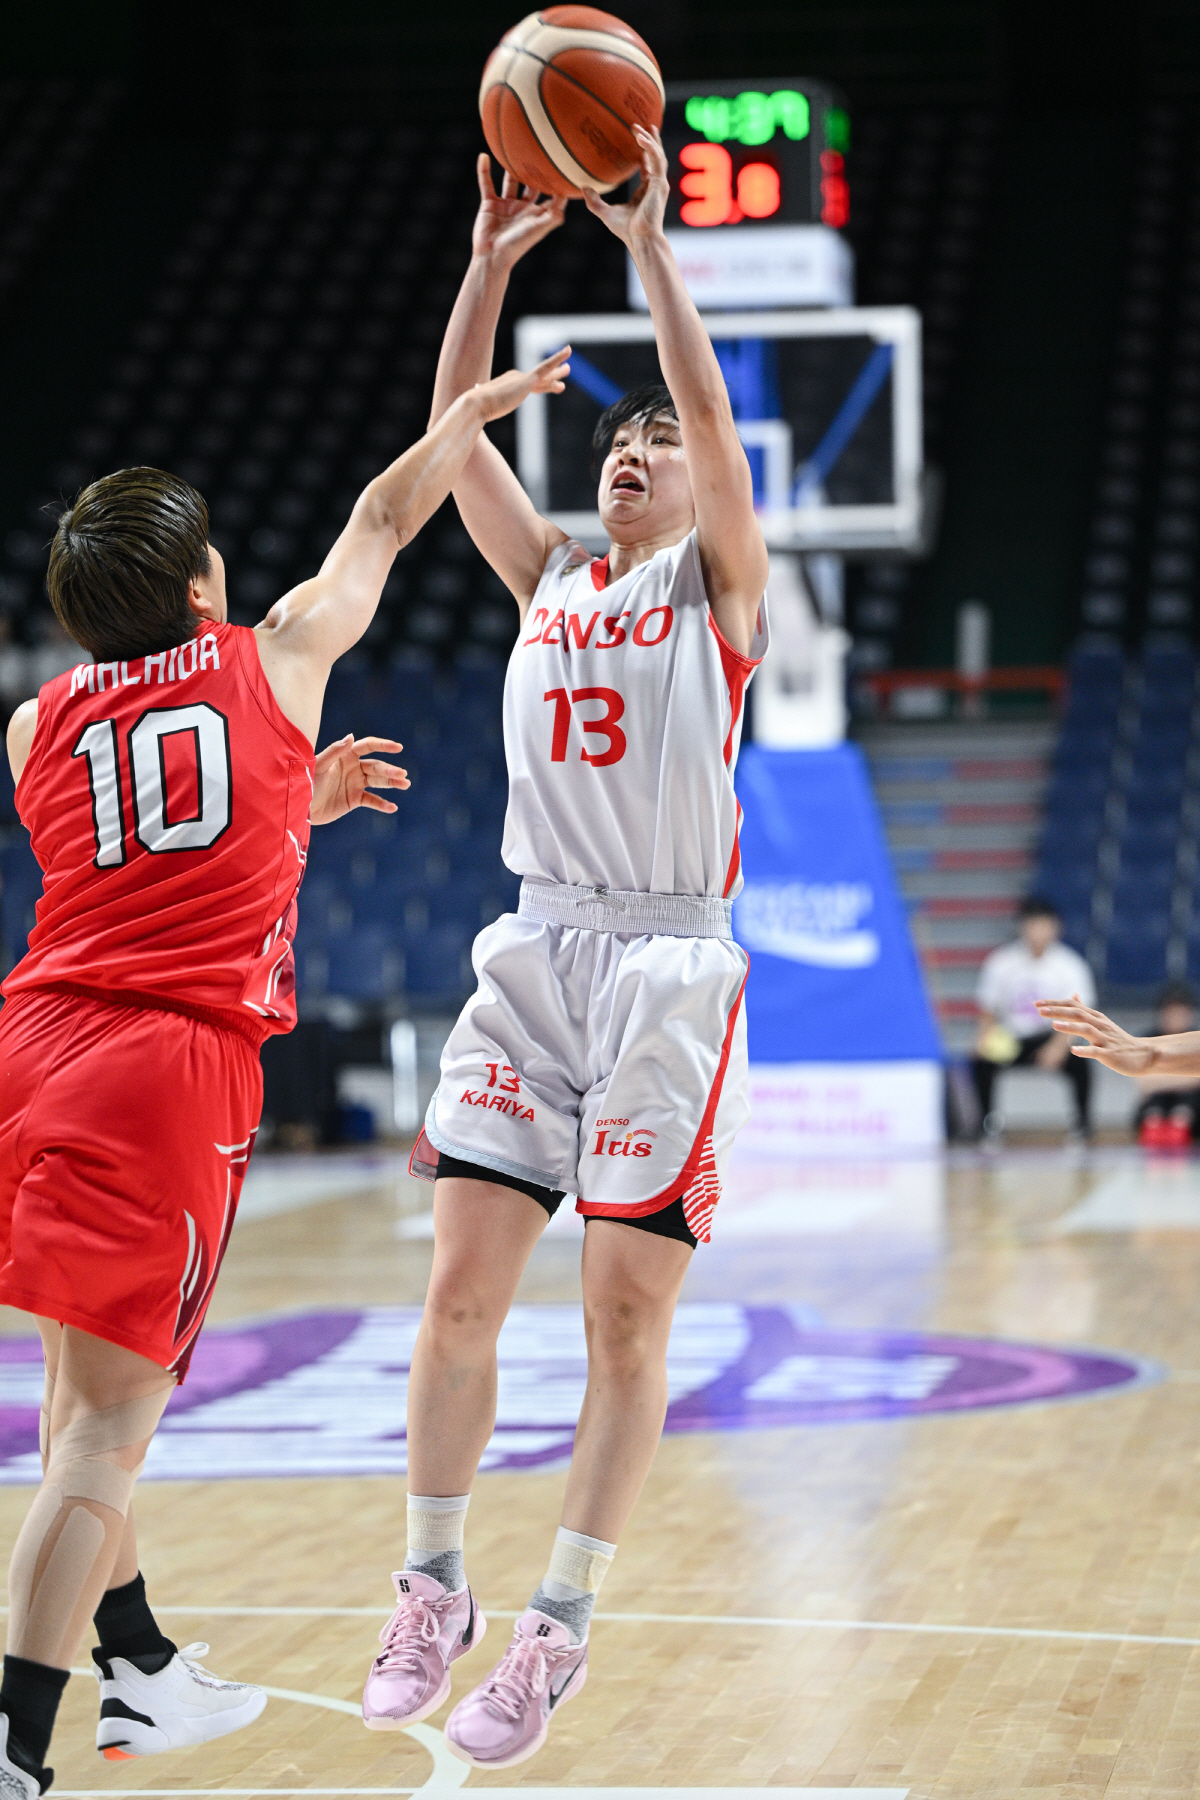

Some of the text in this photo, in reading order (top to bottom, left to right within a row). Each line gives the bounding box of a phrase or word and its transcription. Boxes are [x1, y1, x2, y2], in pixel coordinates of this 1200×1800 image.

[523, 605, 674, 653] DENSO
[543, 686, 627, 768] 13
[71, 701, 233, 870] 10
[485, 1063, 521, 1094] 13
[460, 1089, 535, 1122] KARIYA
[595, 1118, 630, 1127] DENSO
[591, 1130, 652, 1157] Iris
